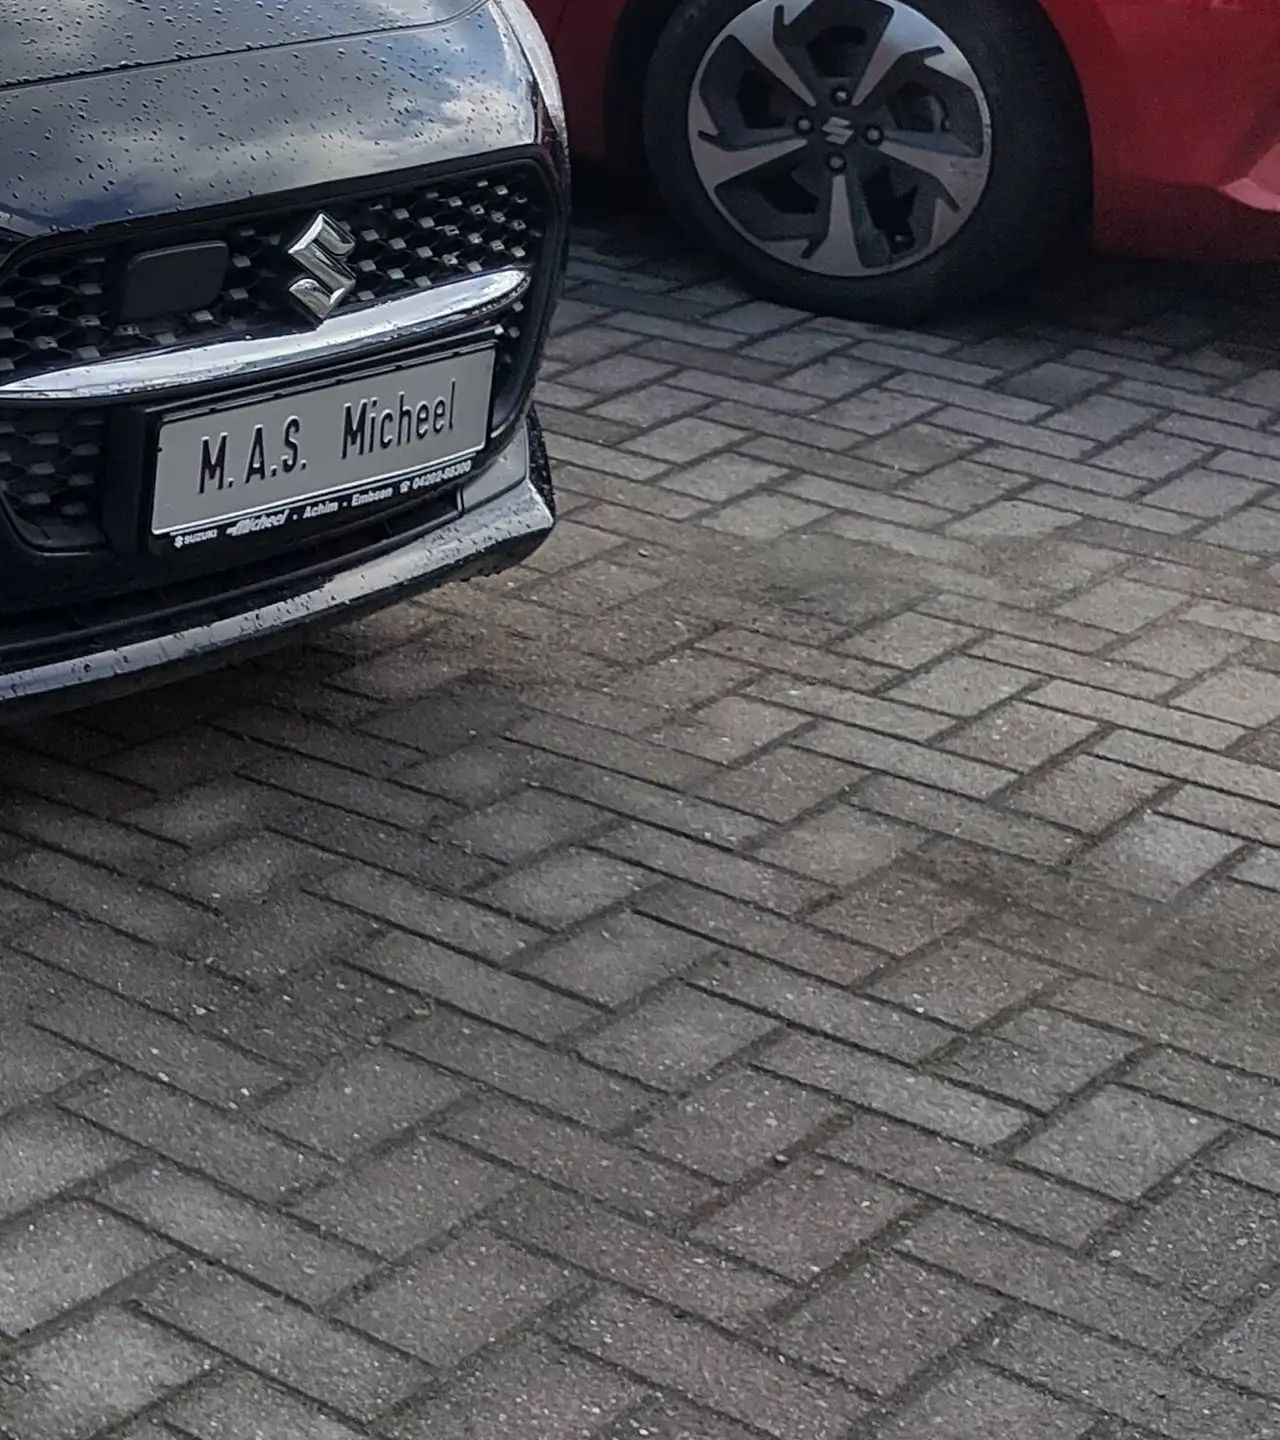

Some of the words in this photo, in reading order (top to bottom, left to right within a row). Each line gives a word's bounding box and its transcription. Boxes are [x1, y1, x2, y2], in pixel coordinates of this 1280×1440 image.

[341, 377, 456, 459] Micheel
[183, 528, 219, 545] SUZUKI
[302, 500, 339, 519] Achim
